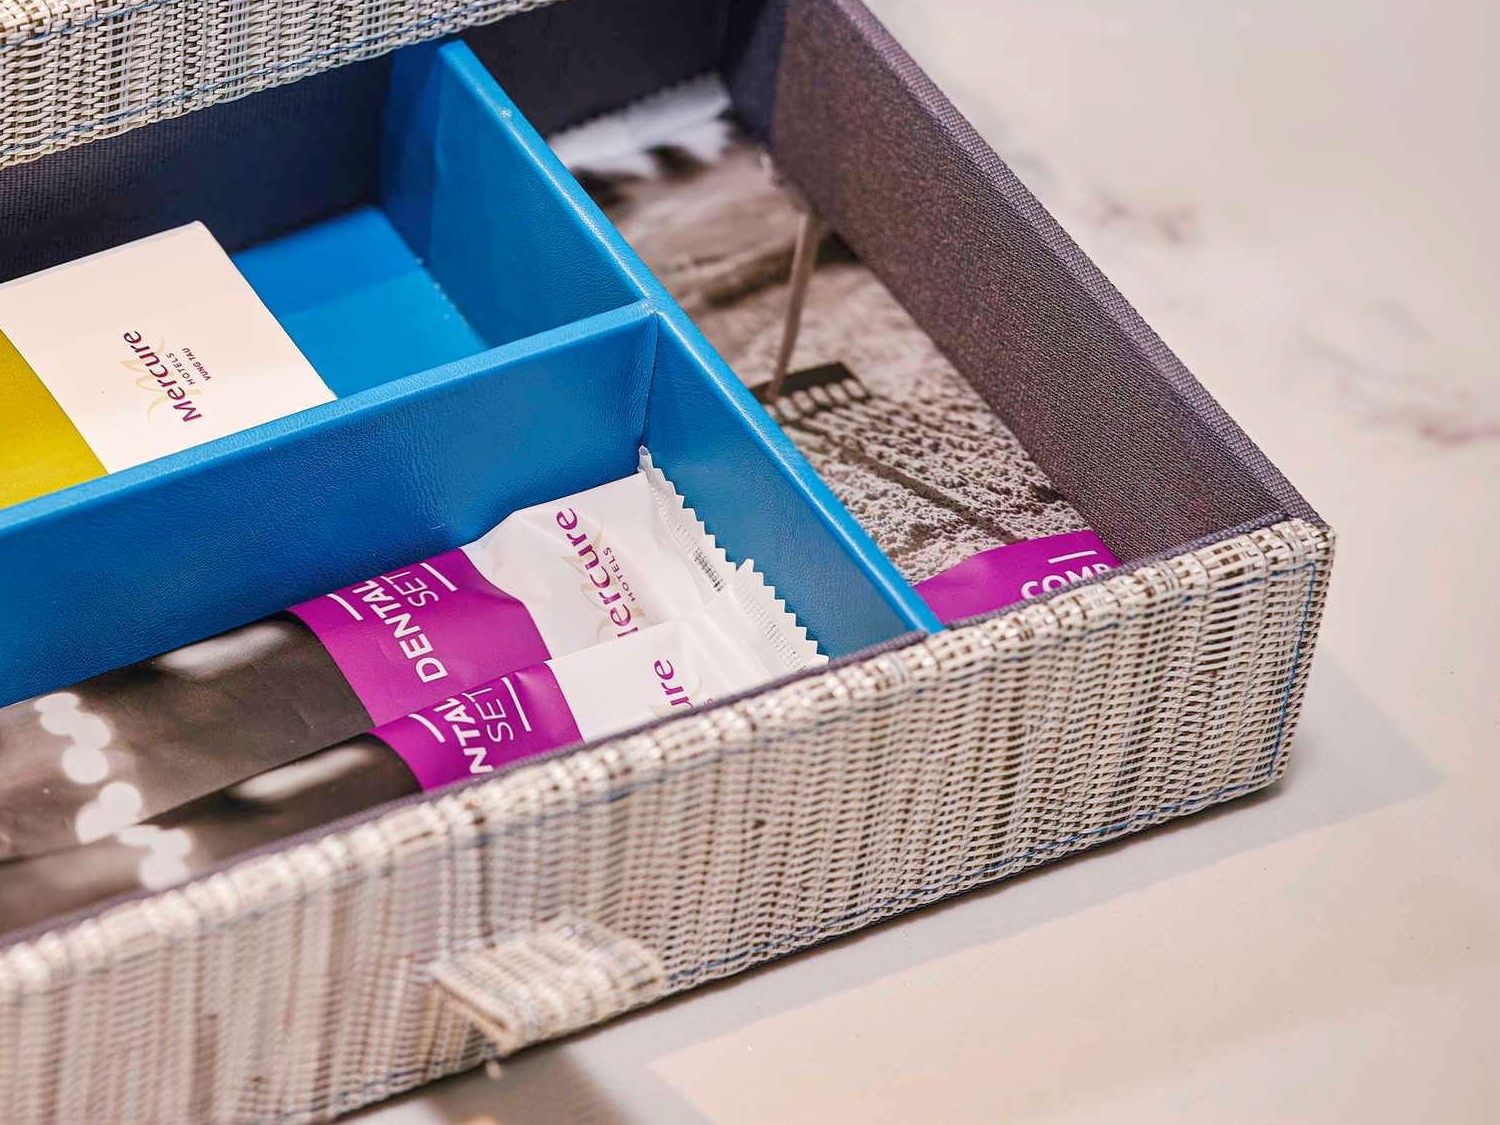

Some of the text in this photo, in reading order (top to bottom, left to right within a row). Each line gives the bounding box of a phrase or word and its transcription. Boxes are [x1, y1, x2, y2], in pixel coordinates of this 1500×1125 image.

[123, 330, 202, 422] Mercure
[166, 352, 196, 386] HOTELS
[181, 347, 211, 381] VUNG TAU
[380, 571, 439, 607] SET
[556, 508, 639, 637] ercure
[603, 547, 636, 602] HOTELS
[352, 580, 449, 683] DENTAL
[434, 698, 494, 774] NTAL
[462, 687, 514, 743] SET
